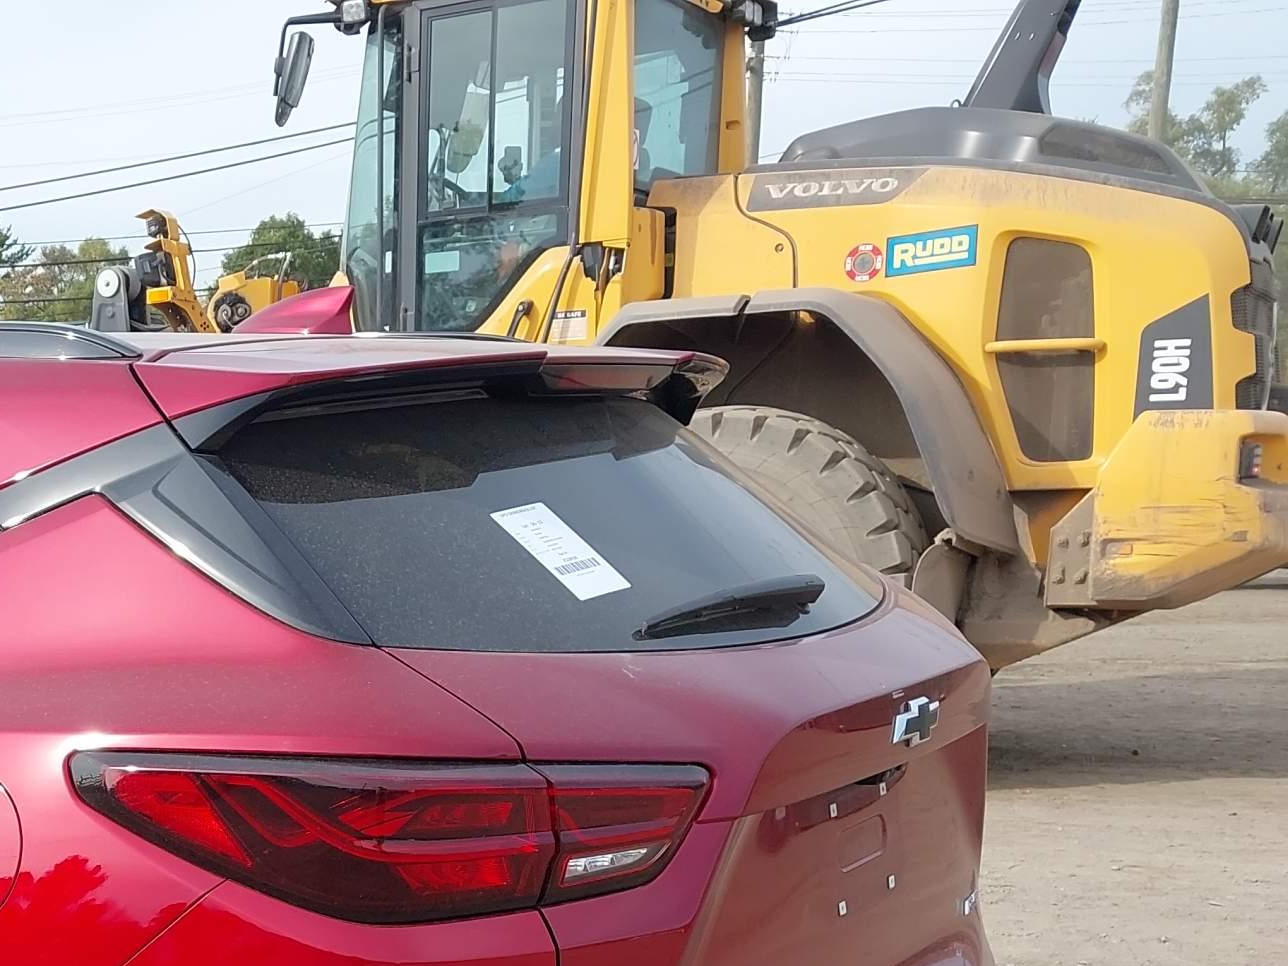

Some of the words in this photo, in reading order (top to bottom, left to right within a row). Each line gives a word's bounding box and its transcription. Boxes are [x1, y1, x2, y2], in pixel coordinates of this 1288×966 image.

[765, 177, 899, 200] VOLVO
[892, 234, 971, 269] RUDD
[1149, 338, 1192, 402] L90H
